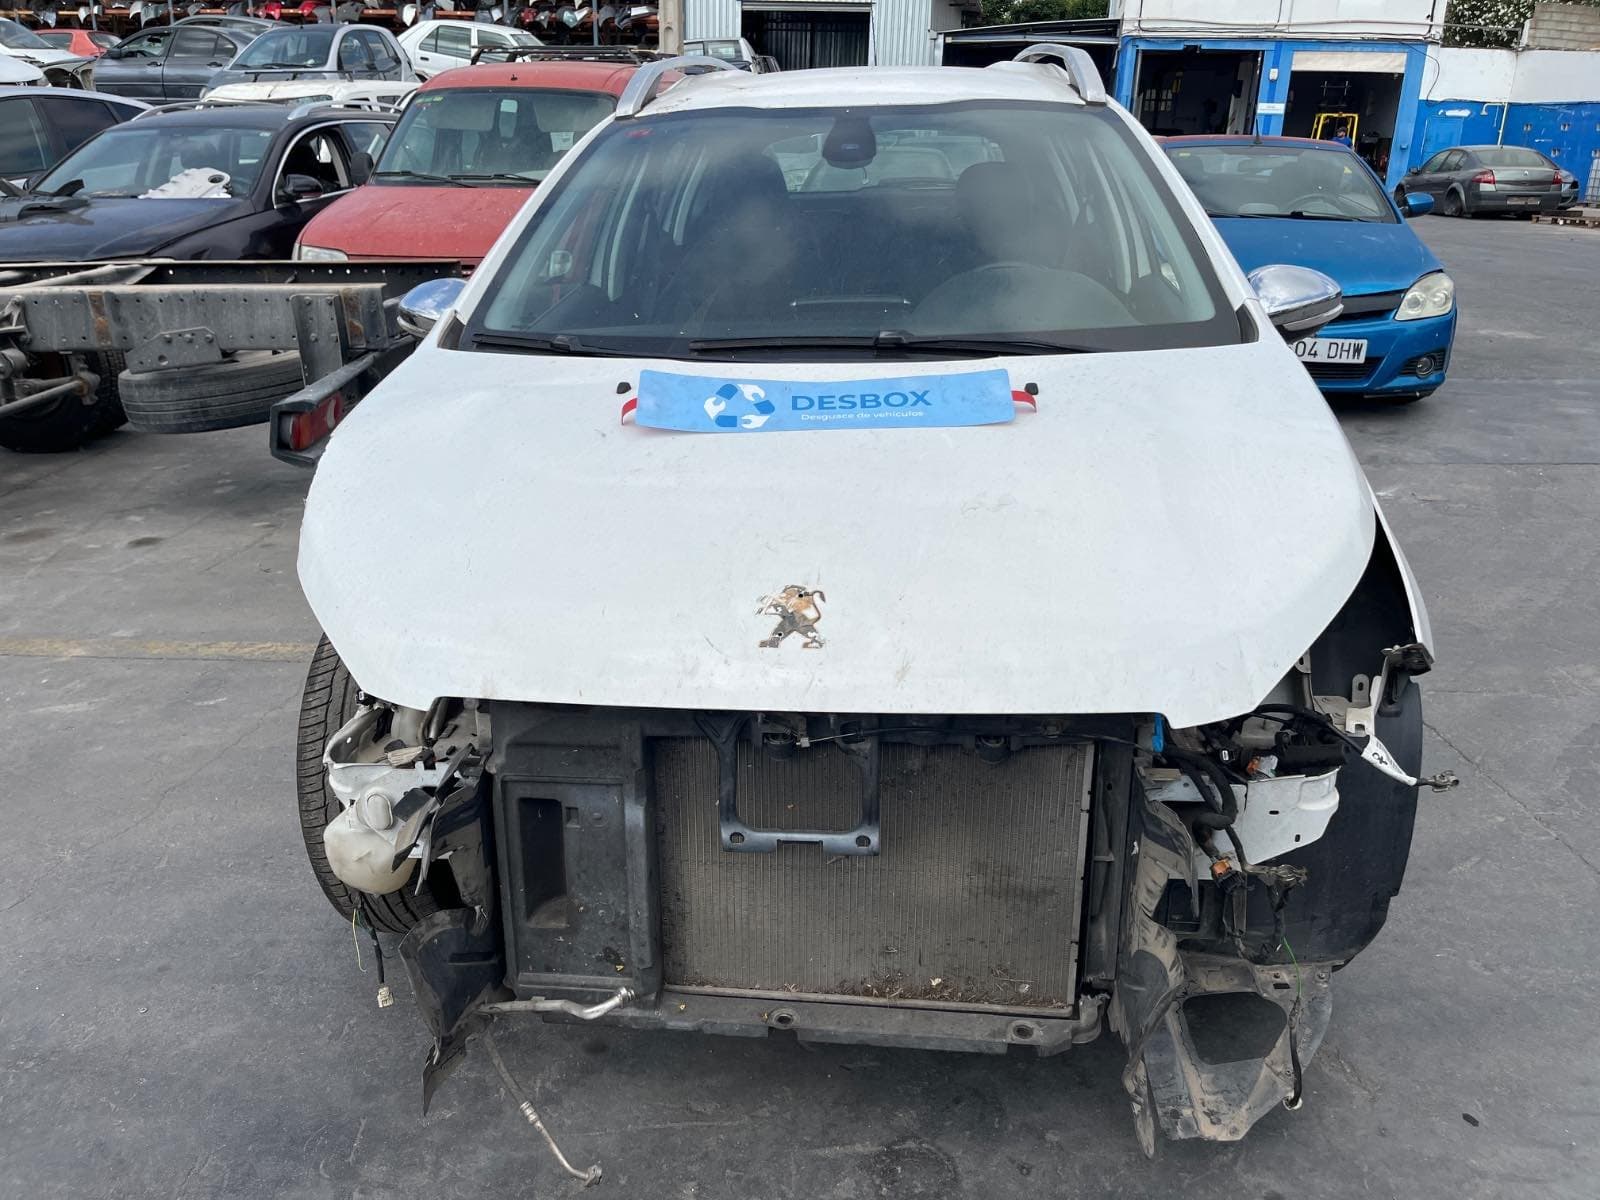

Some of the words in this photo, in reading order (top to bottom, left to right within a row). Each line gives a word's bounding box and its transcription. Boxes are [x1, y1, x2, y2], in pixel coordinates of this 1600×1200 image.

[1289, 341, 1318, 358] 04
[1327, 342, 1363, 360] DHW
[791, 390, 932, 411] DESBOX
[801, 413, 854, 421] Desguace
